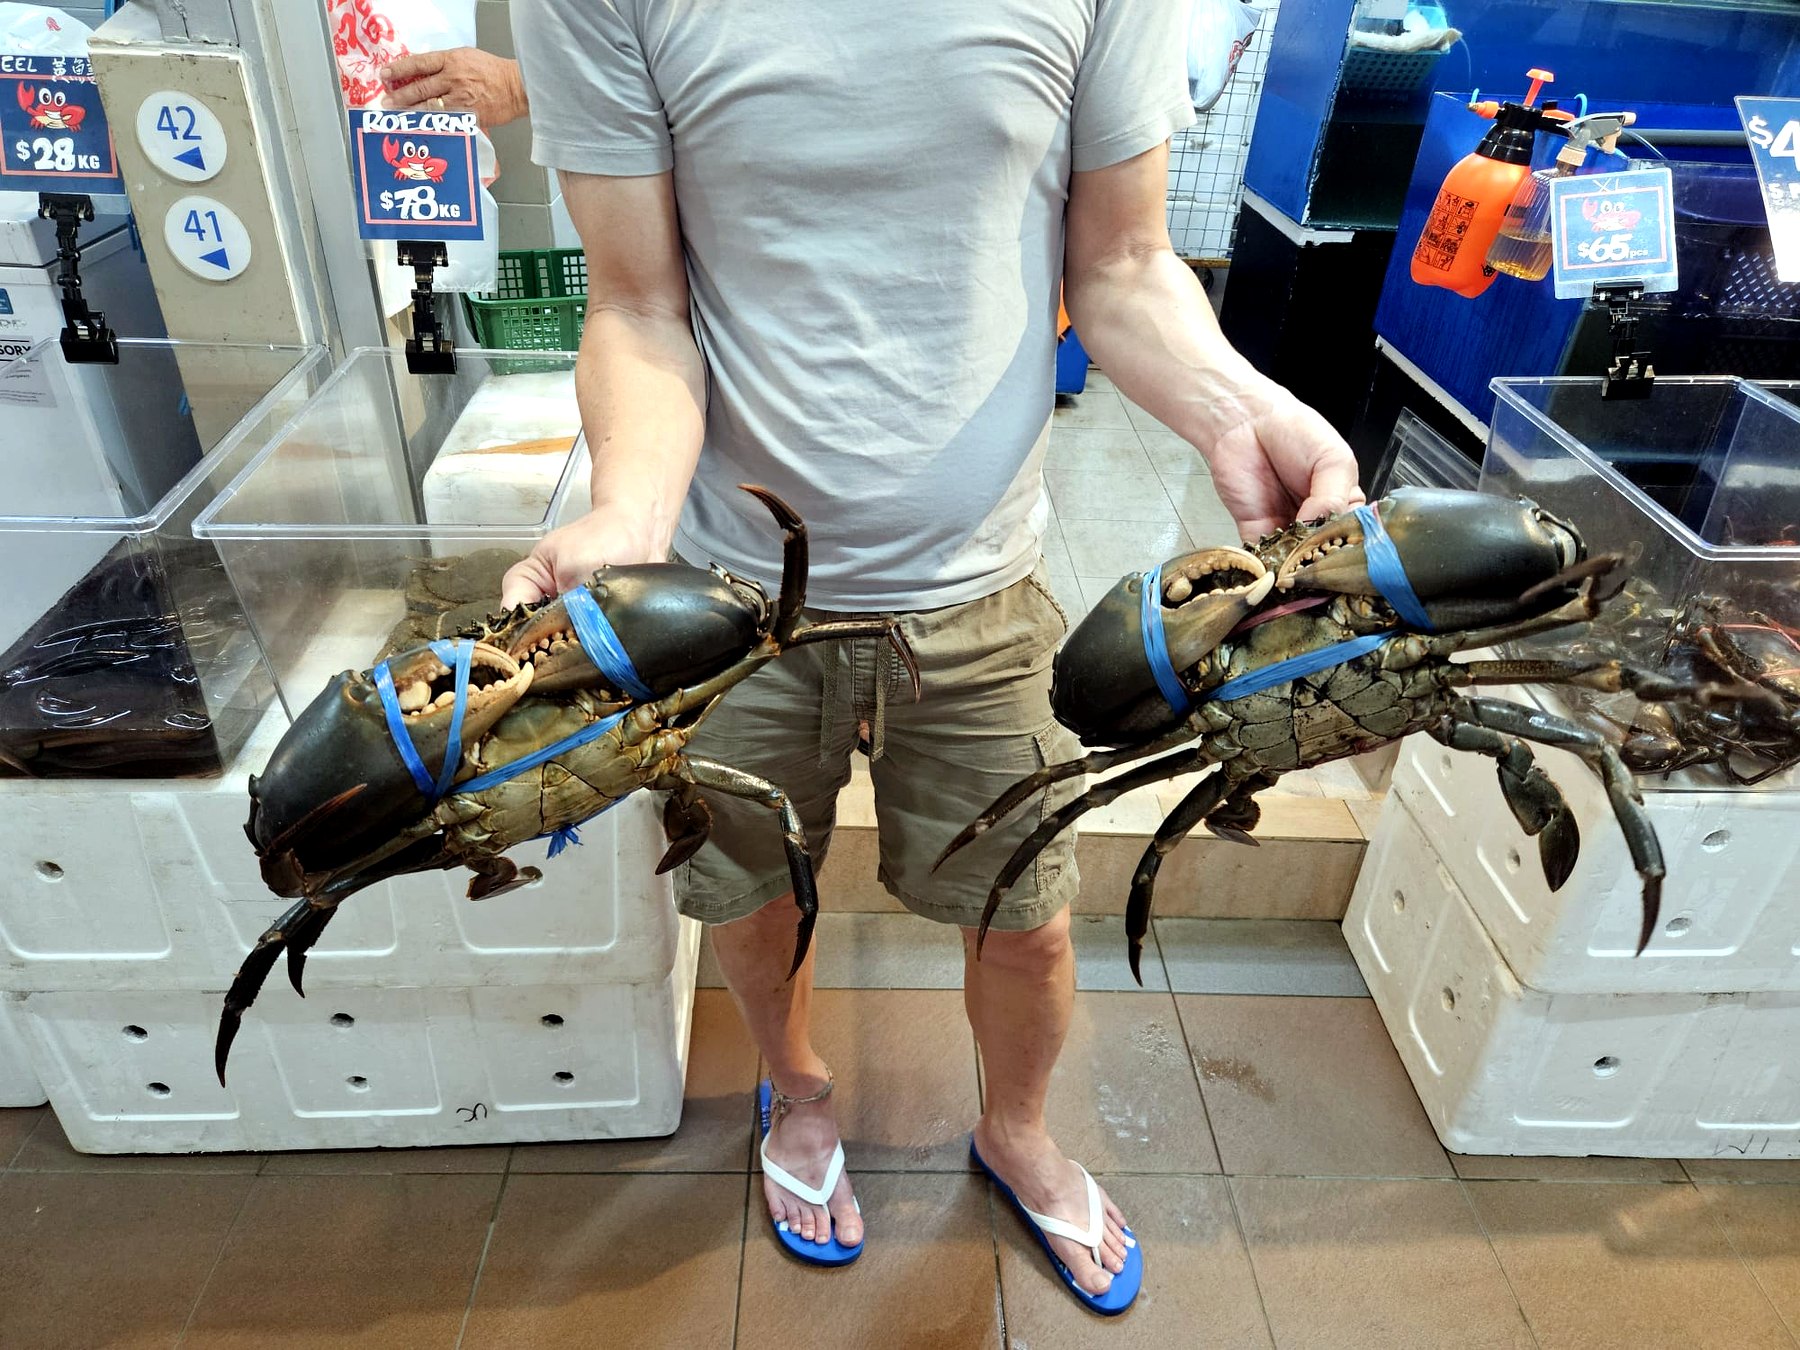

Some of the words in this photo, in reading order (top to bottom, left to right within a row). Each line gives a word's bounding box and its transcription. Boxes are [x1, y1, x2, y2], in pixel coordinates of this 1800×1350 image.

[1, 56, 38, 73] EEL
[156, 105, 202, 141] 42
[184, 210, 222, 242] 41
